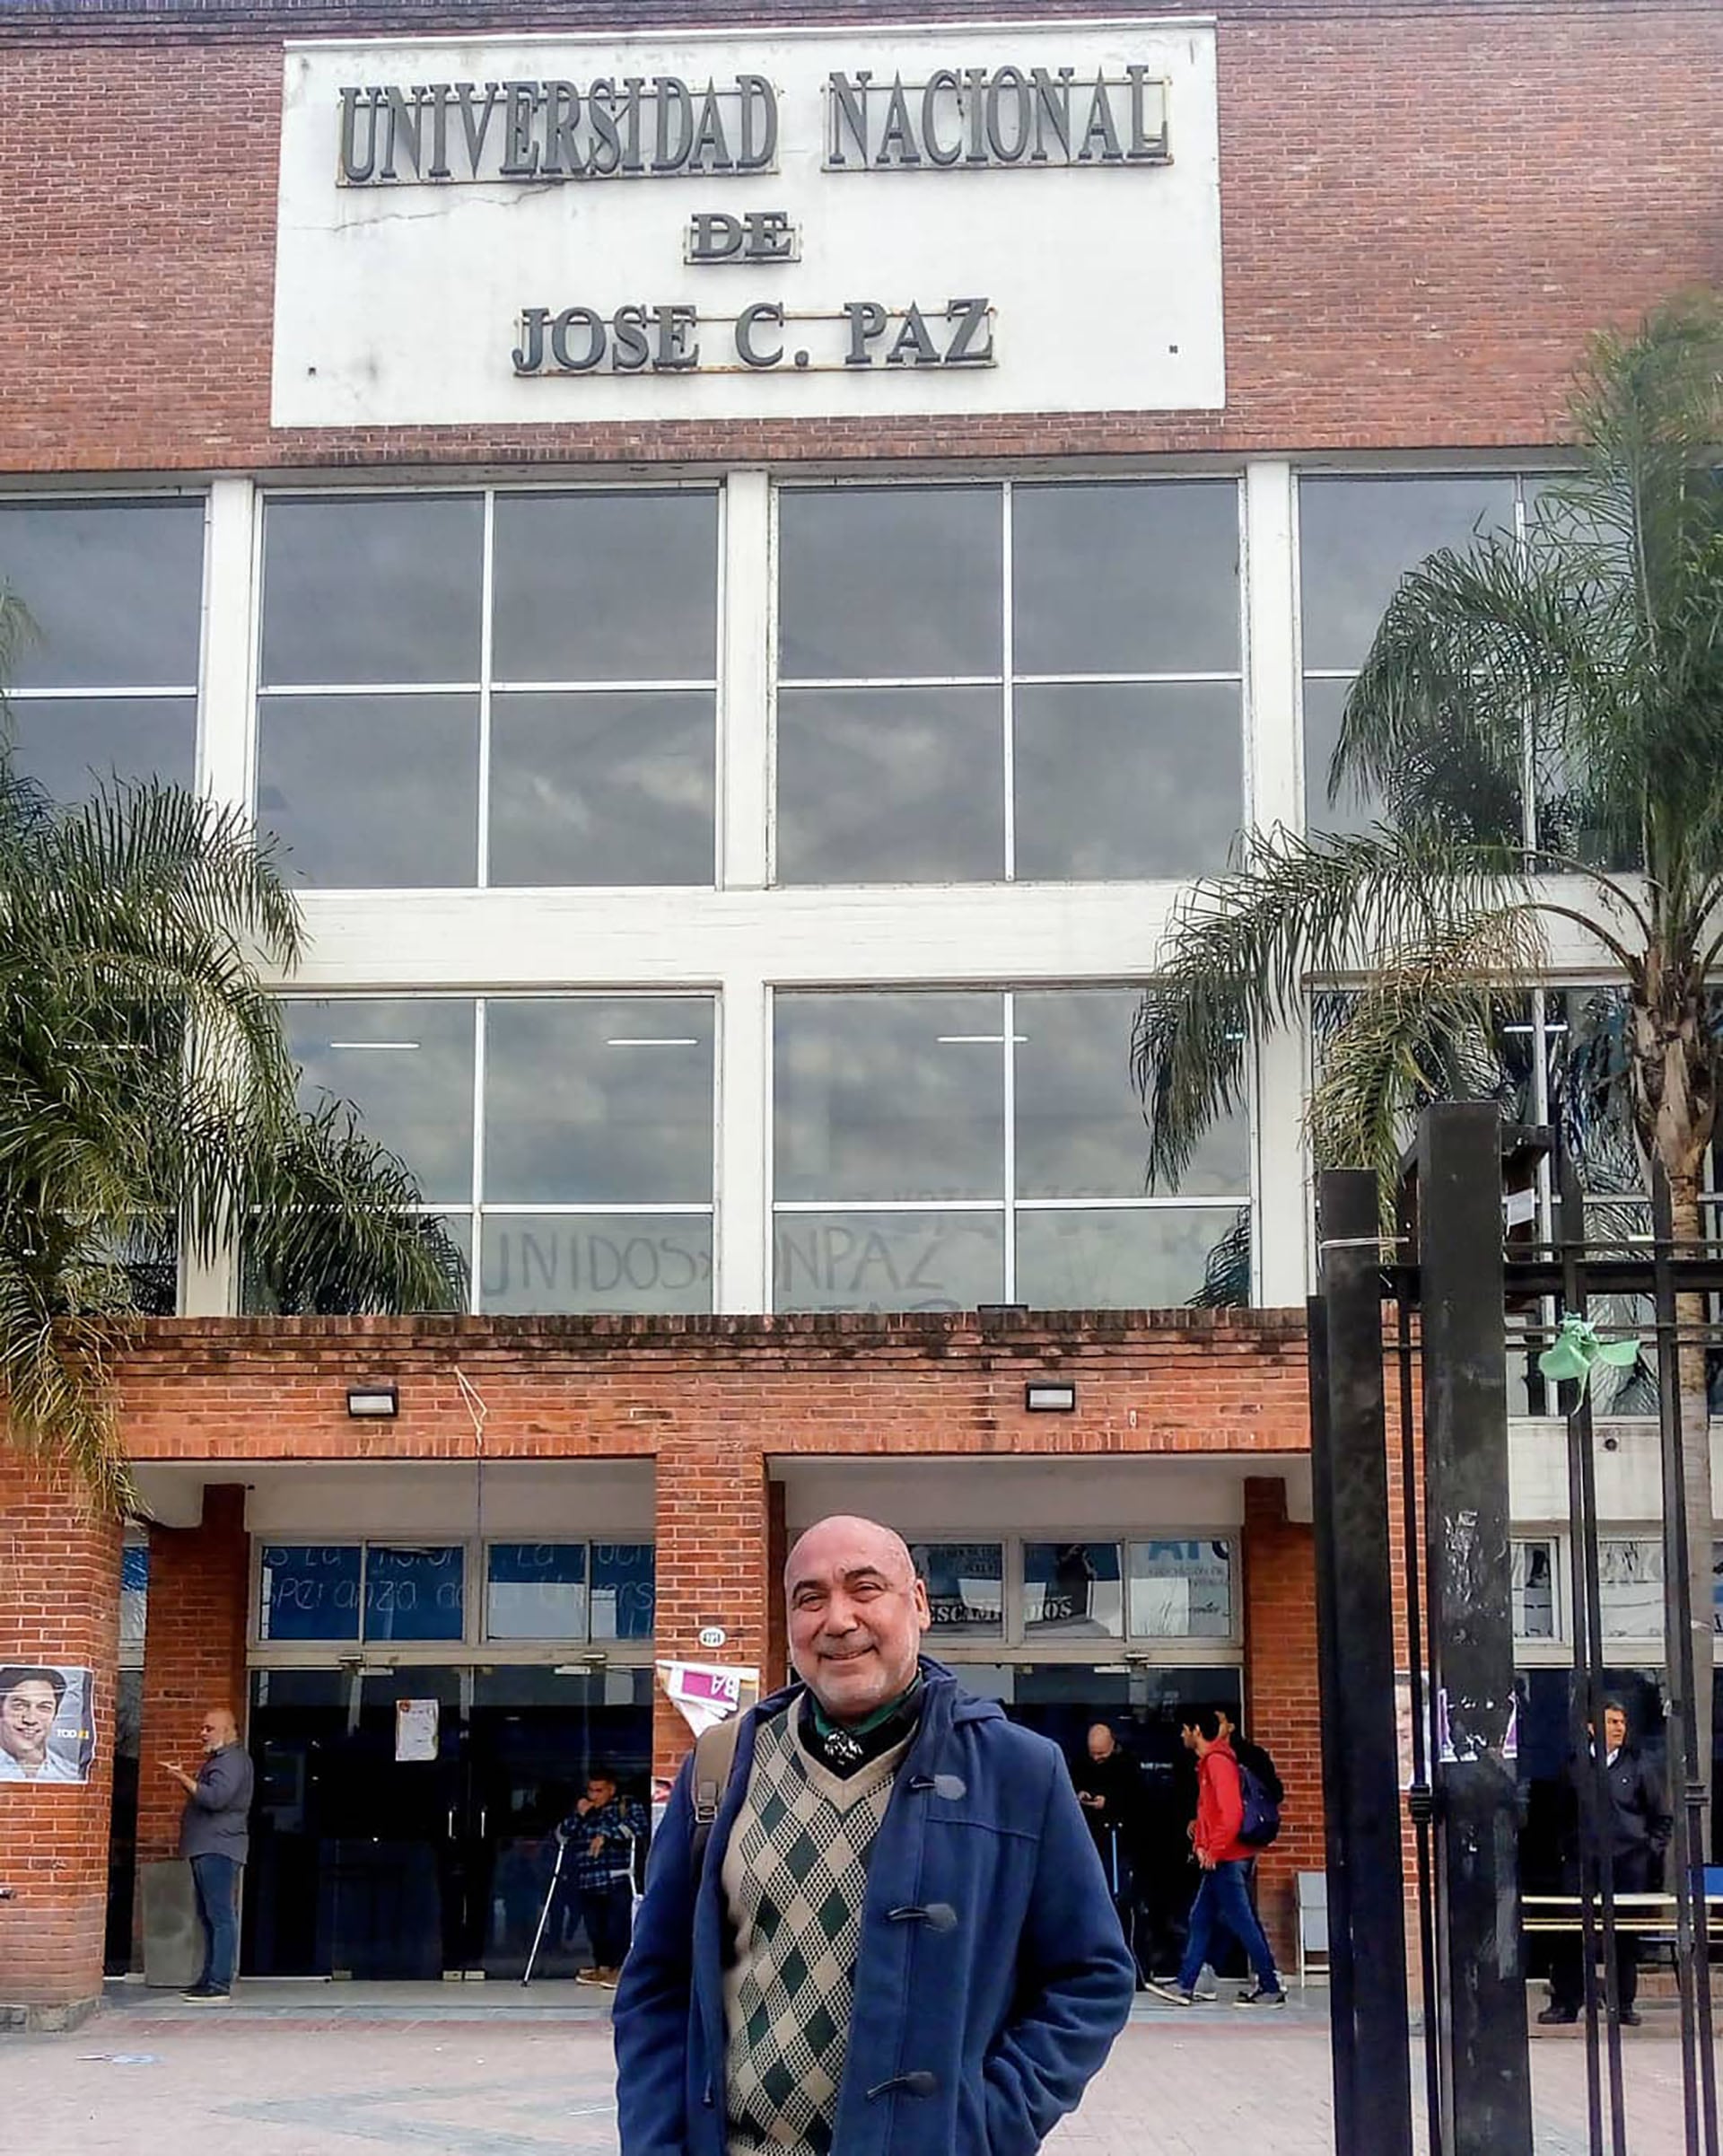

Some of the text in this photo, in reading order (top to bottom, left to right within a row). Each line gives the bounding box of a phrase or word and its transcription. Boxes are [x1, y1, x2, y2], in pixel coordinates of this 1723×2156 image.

[337, 65, 1169, 180] UNIVERSIDAD NACIONAL
[691, 210, 792, 259] DE
[512, 296, 994, 372] JOSE C. PAZ
